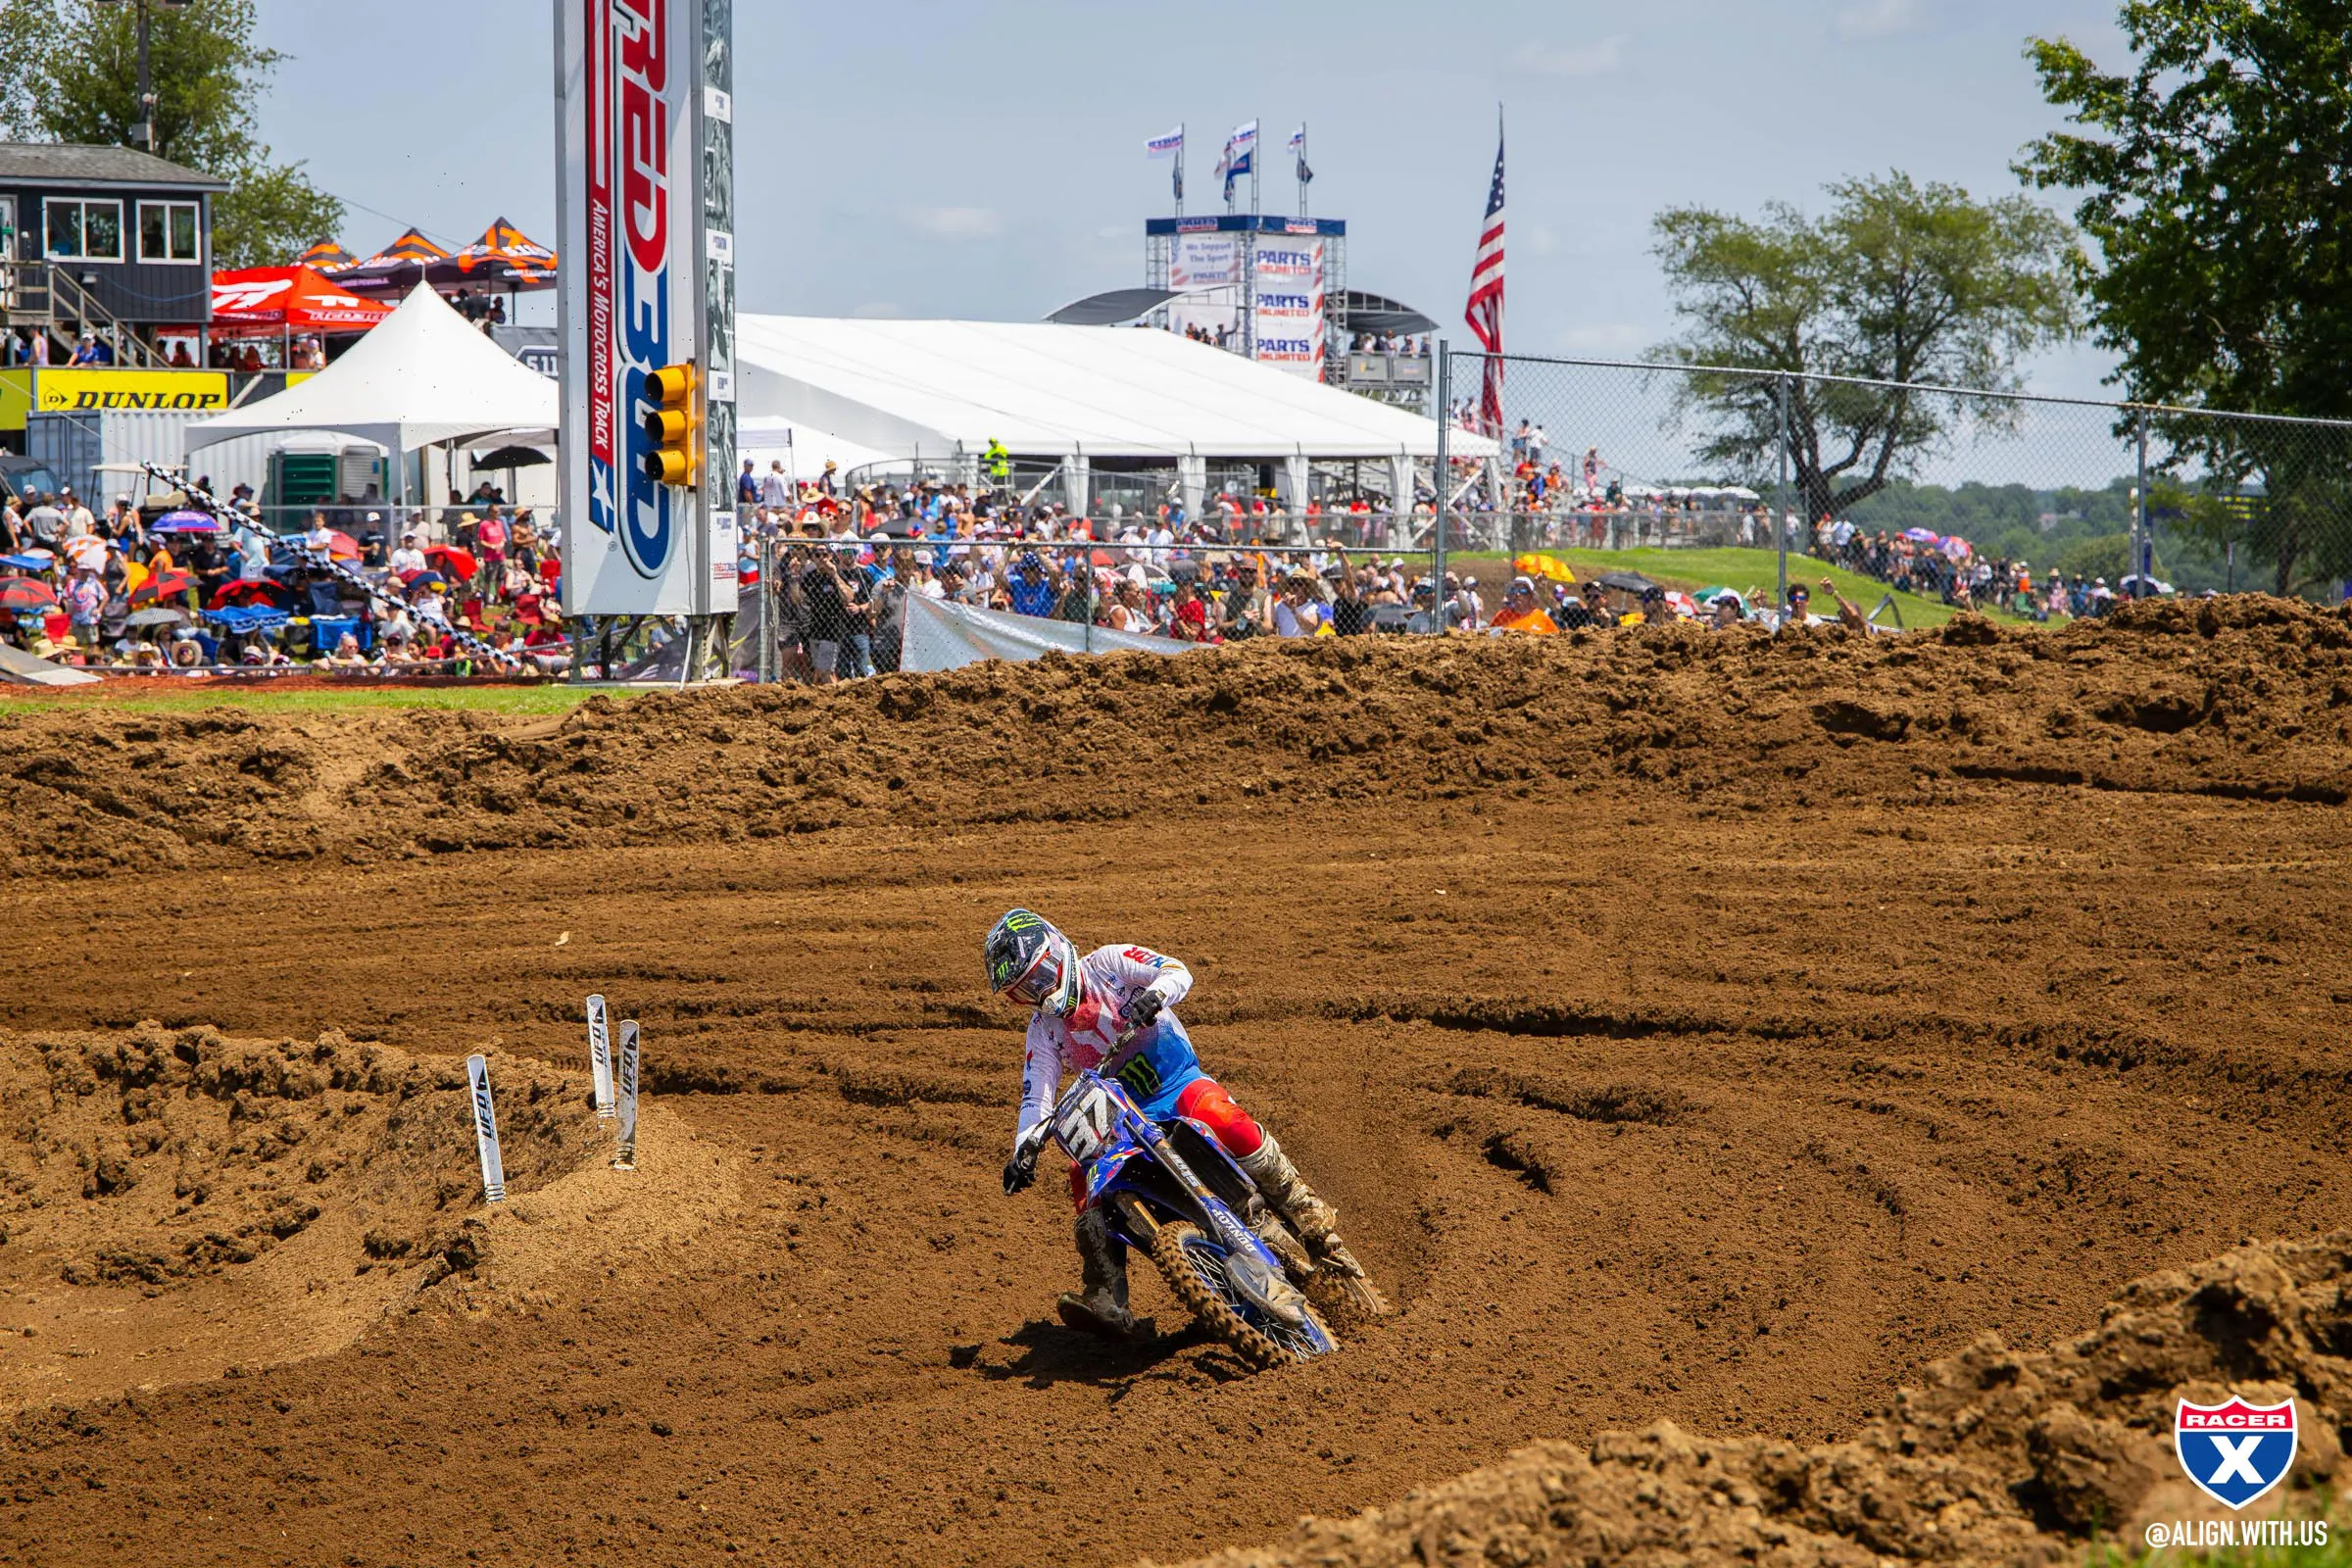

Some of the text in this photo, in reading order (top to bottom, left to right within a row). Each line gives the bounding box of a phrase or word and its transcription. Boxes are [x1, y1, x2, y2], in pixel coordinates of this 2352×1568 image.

[1257, 250, 1310, 266] PARTS
[1256, 294, 1309, 308] PARTS
[592, 197, 610, 450] AMERICA'S MOTOCROSS TRACK
[1257, 339, 1310, 352] PARTS
[74, 391, 220, 410] DUNLOP
[593, 1027, 604, 1065] UFO
[622, 1053, 634, 1097] UFO
[476, 1092, 492, 1140] UFO
[1058, 1086, 1111, 1162] 37
[1211, 1208, 1258, 1253] DUNLOP
